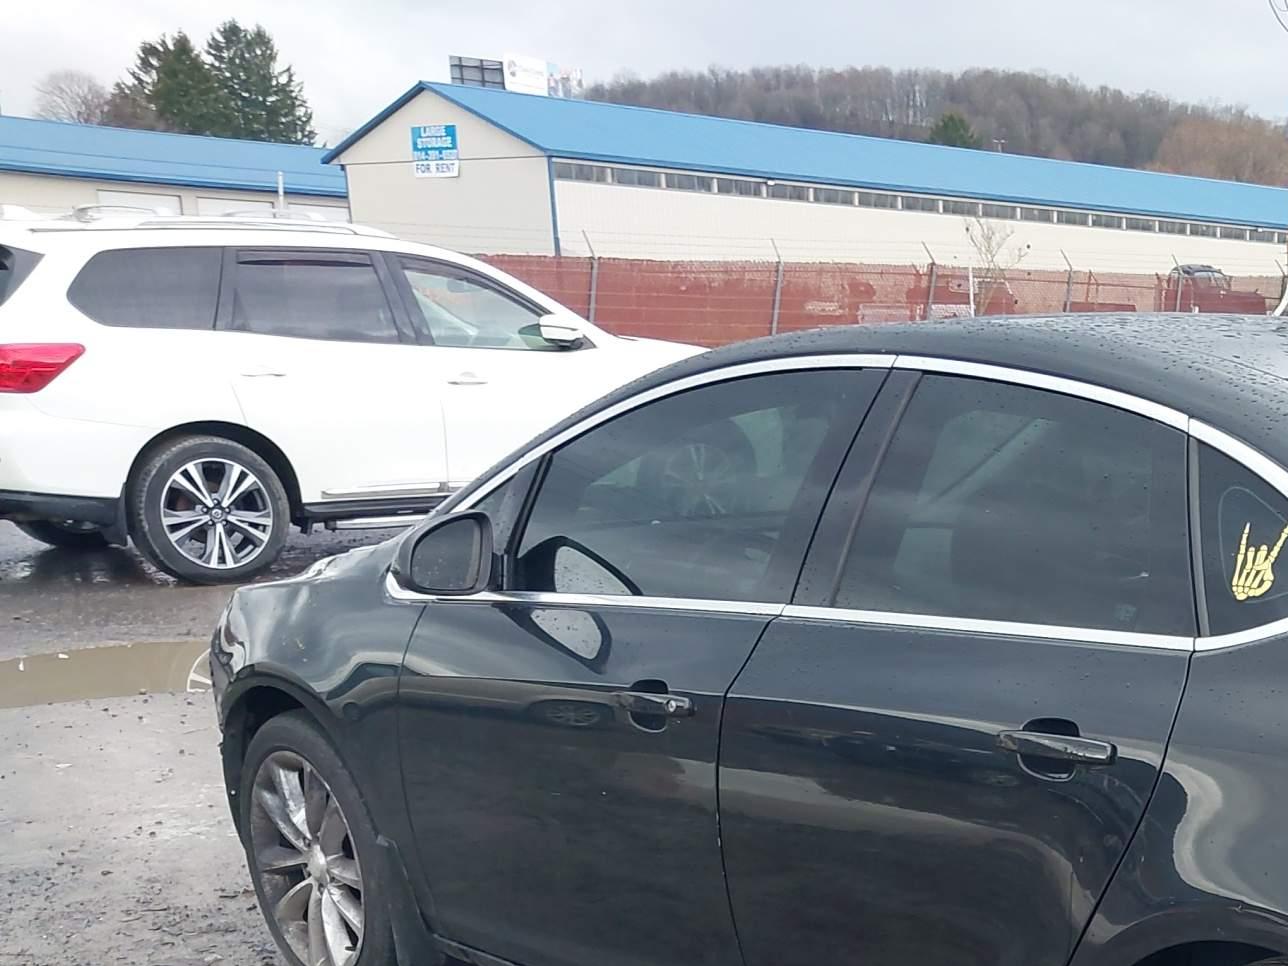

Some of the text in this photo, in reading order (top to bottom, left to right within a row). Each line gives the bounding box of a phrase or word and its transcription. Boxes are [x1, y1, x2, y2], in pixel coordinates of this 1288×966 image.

[416, 136, 453, 149] STORAGE
[415, 161, 456, 174] FOR RENT
